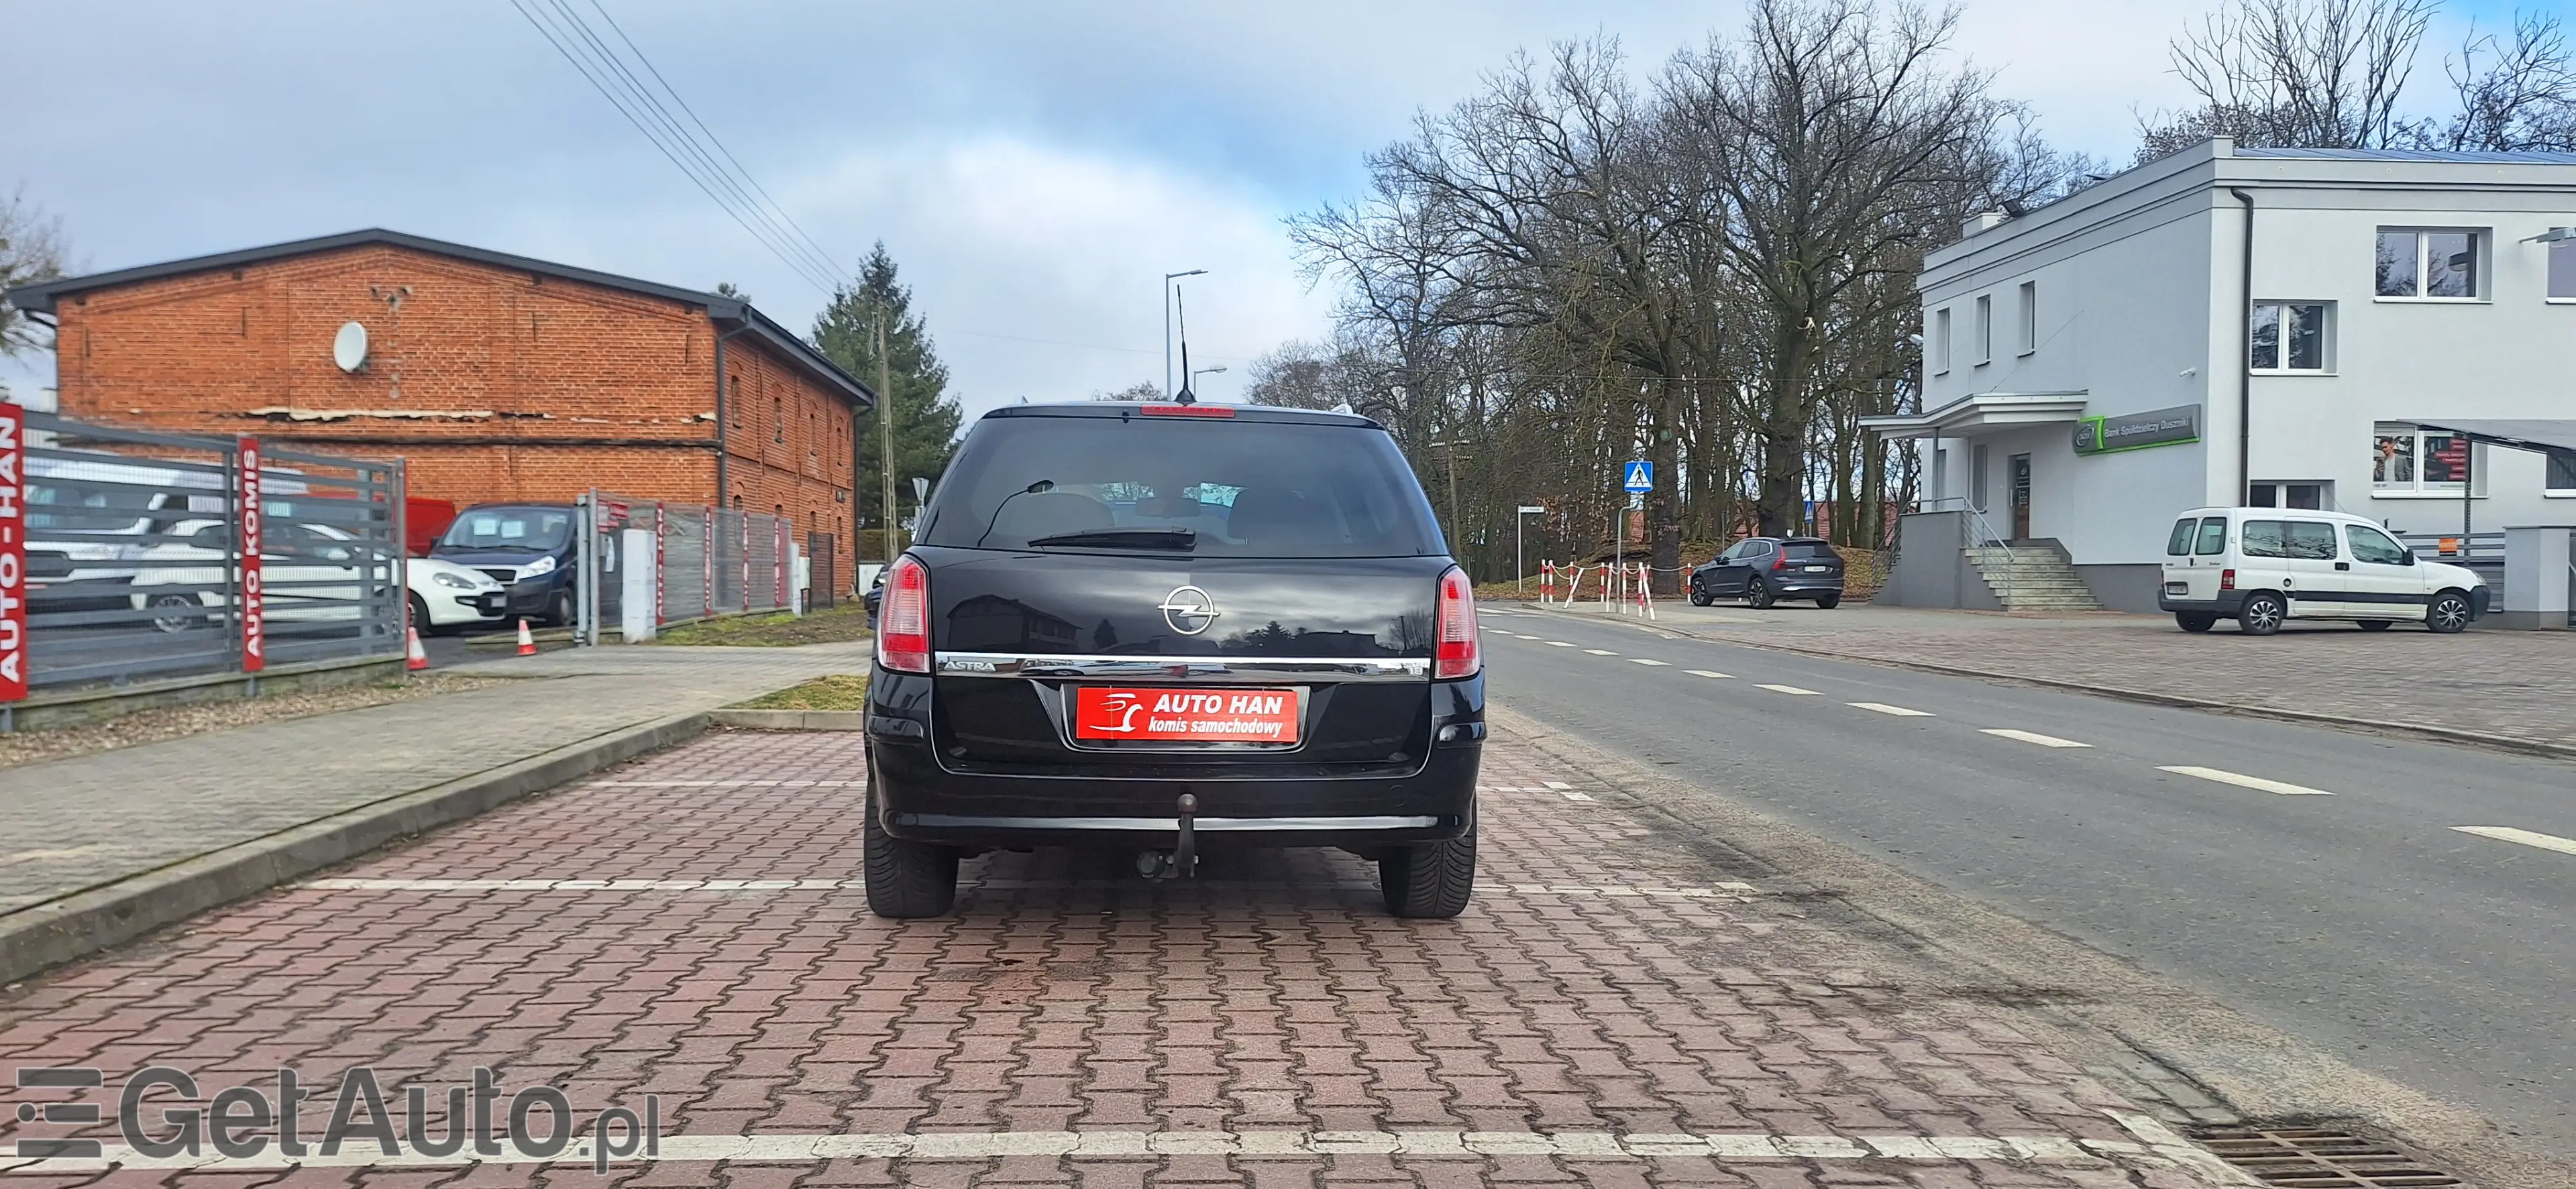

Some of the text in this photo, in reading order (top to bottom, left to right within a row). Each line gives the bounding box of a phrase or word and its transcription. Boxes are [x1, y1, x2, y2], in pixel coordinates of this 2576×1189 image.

[2104, 428, 2120, 439] Bank
[2161, 416, 2190, 430] Duszniki
[0, 416, 17, 518] HAN
[243, 449, 262, 657] AUTO KOMIS
[0, 552, 19, 683] AUTO
[943, 661, 996, 672] ASTRA
[1152, 693, 1283, 715] AUTO HAN
[1148, 716, 1283, 738] komis samochodowy
